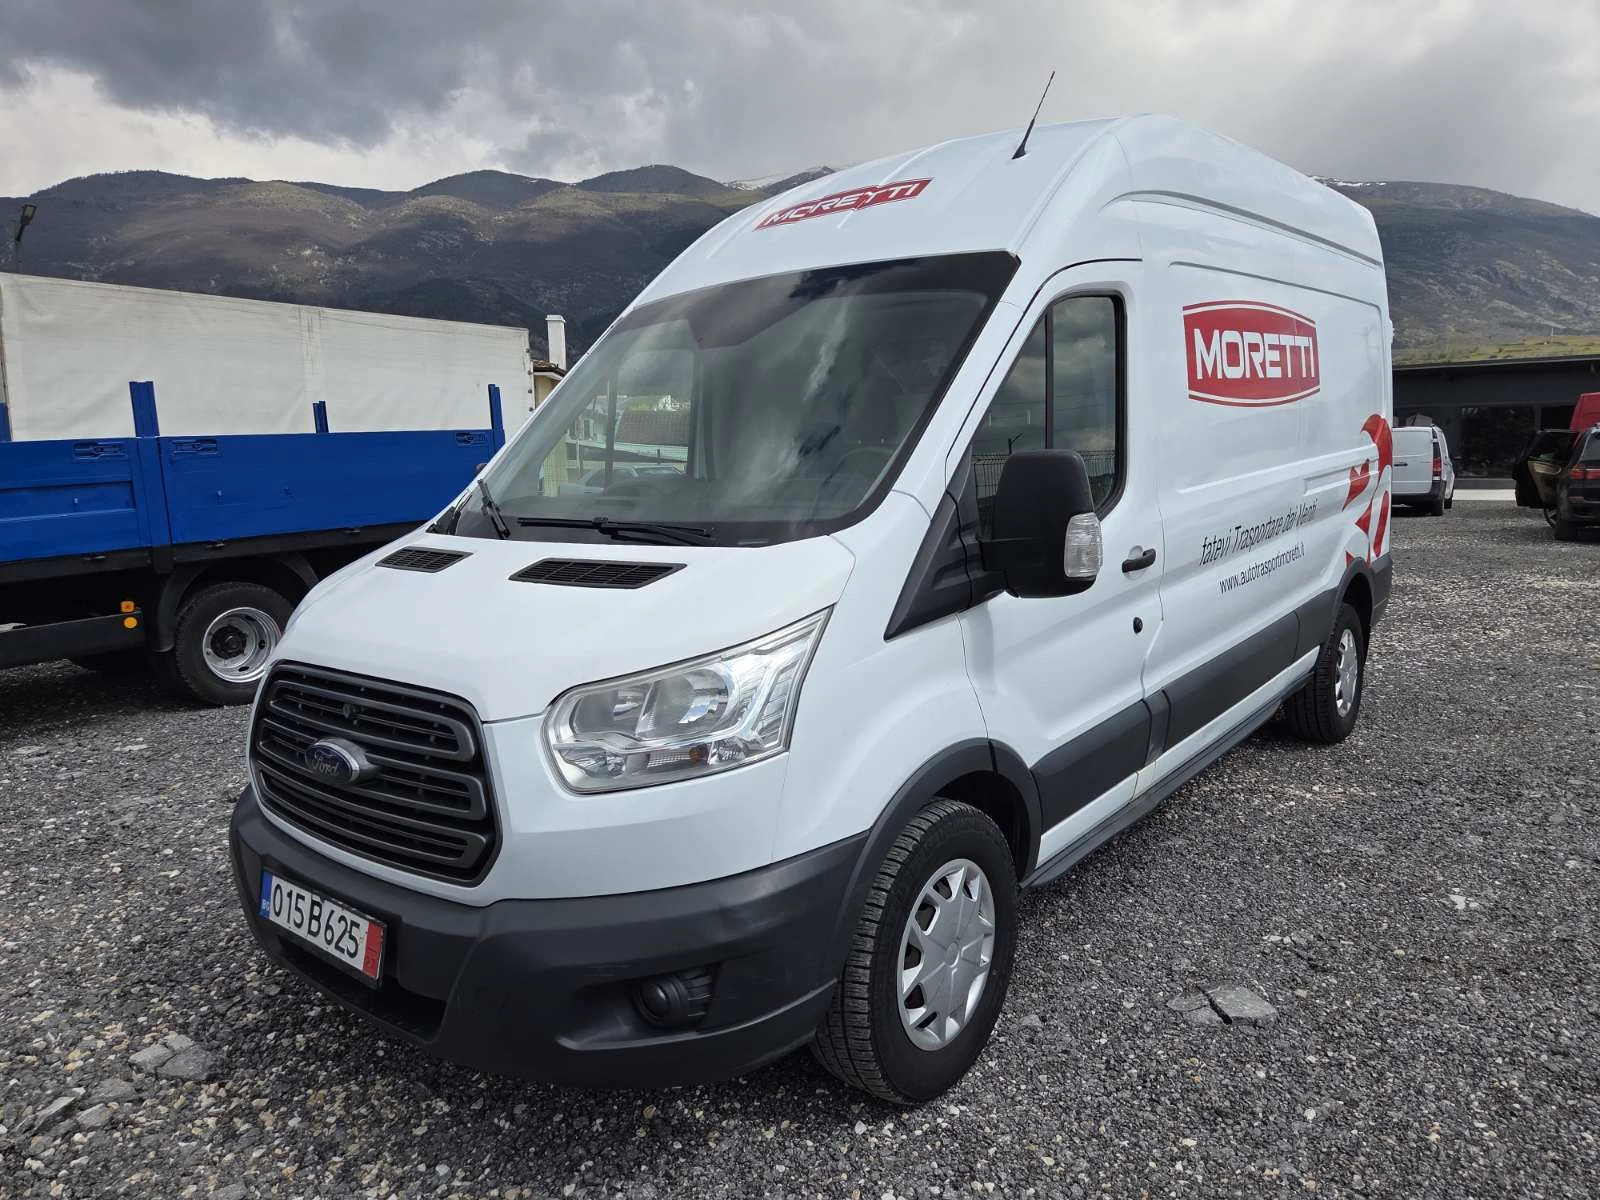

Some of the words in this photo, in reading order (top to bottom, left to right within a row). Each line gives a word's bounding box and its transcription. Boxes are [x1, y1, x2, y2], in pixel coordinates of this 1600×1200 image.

[764, 183, 920, 226] MORETTI
[1194, 328, 1315, 380] MORETTI
[1200, 529, 1231, 566] fatevi
[1232, 516, 1283, 552] Trasportare
[1282, 507, 1298, 533] dai
[1220, 541, 1305, 594] www.autotrasportimoretti.it
[312, 751, 340, 777] Ford
[272, 883, 360, 959] 015B625
